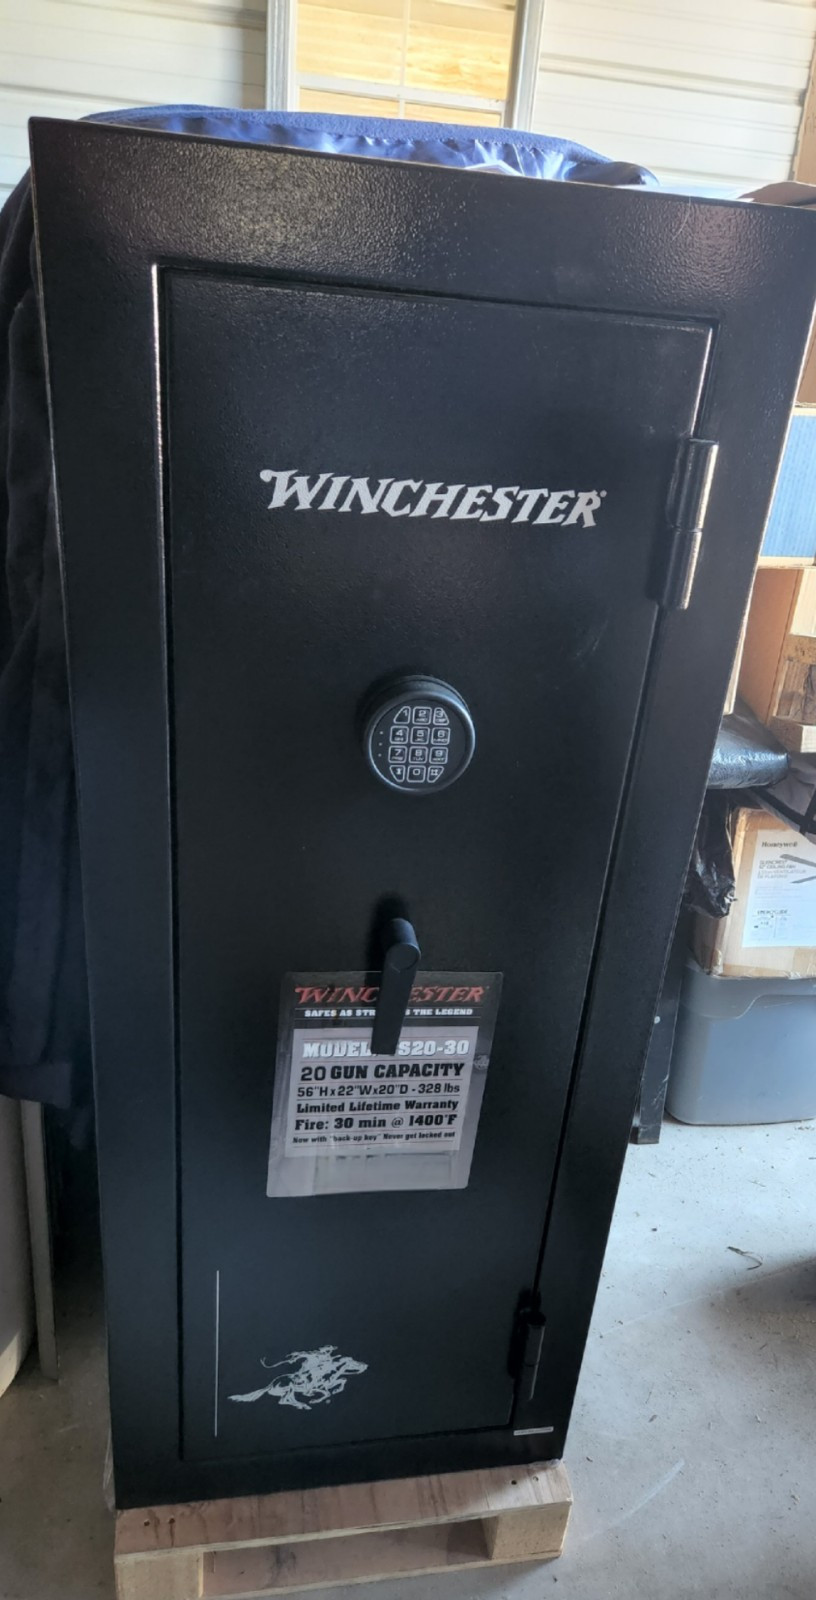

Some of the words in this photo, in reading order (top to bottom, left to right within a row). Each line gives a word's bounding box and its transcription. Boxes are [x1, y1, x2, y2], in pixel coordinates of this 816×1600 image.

[259, 469, 602, 528] WINCHESTER
[418, 709, 426, 717] 2
[435, 710, 443, 718] 3
[416, 729, 424, 737] 5
[437, 730, 445, 738] 6
[394, 748, 402, 756] 7
[415, 749, 422, 757] 8
[435, 749, 443, 757] 9
[412, 768, 421, 776] 0
[294, 986, 484, 1004] WINCESTER
[304, 1009, 337, 1017] SAFES
[339, 1009, 353, 1017] AS
[413, 1008, 433, 1016] THE
[435, 1008, 473, 1016] LEGEND
[302, 1040, 377, 1058] MODEL
[300, 1066, 327, 1081] 20
[330, 1065, 369, 1080] GUN
[373, 1063, 465, 1079] CAPACITY
[418, 1083, 441, 1094] 328
[443, 1082, 460, 1093] lbs
[296, 1102, 345, 1114] Limited
[349, 1101, 401, 1112] Lifetime
[404, 1099, 459, 1111] Warranty
[294, 1118, 329, 1131] Fire:
[333, 1117, 354, 1129] 30
[358, 1116, 386, 1128] min
[391, 1116, 404, 1128] @
[311, 1135, 327, 1143] with
[405, 1132, 417, 1141] get
[418, 1131, 442, 1139] locked
